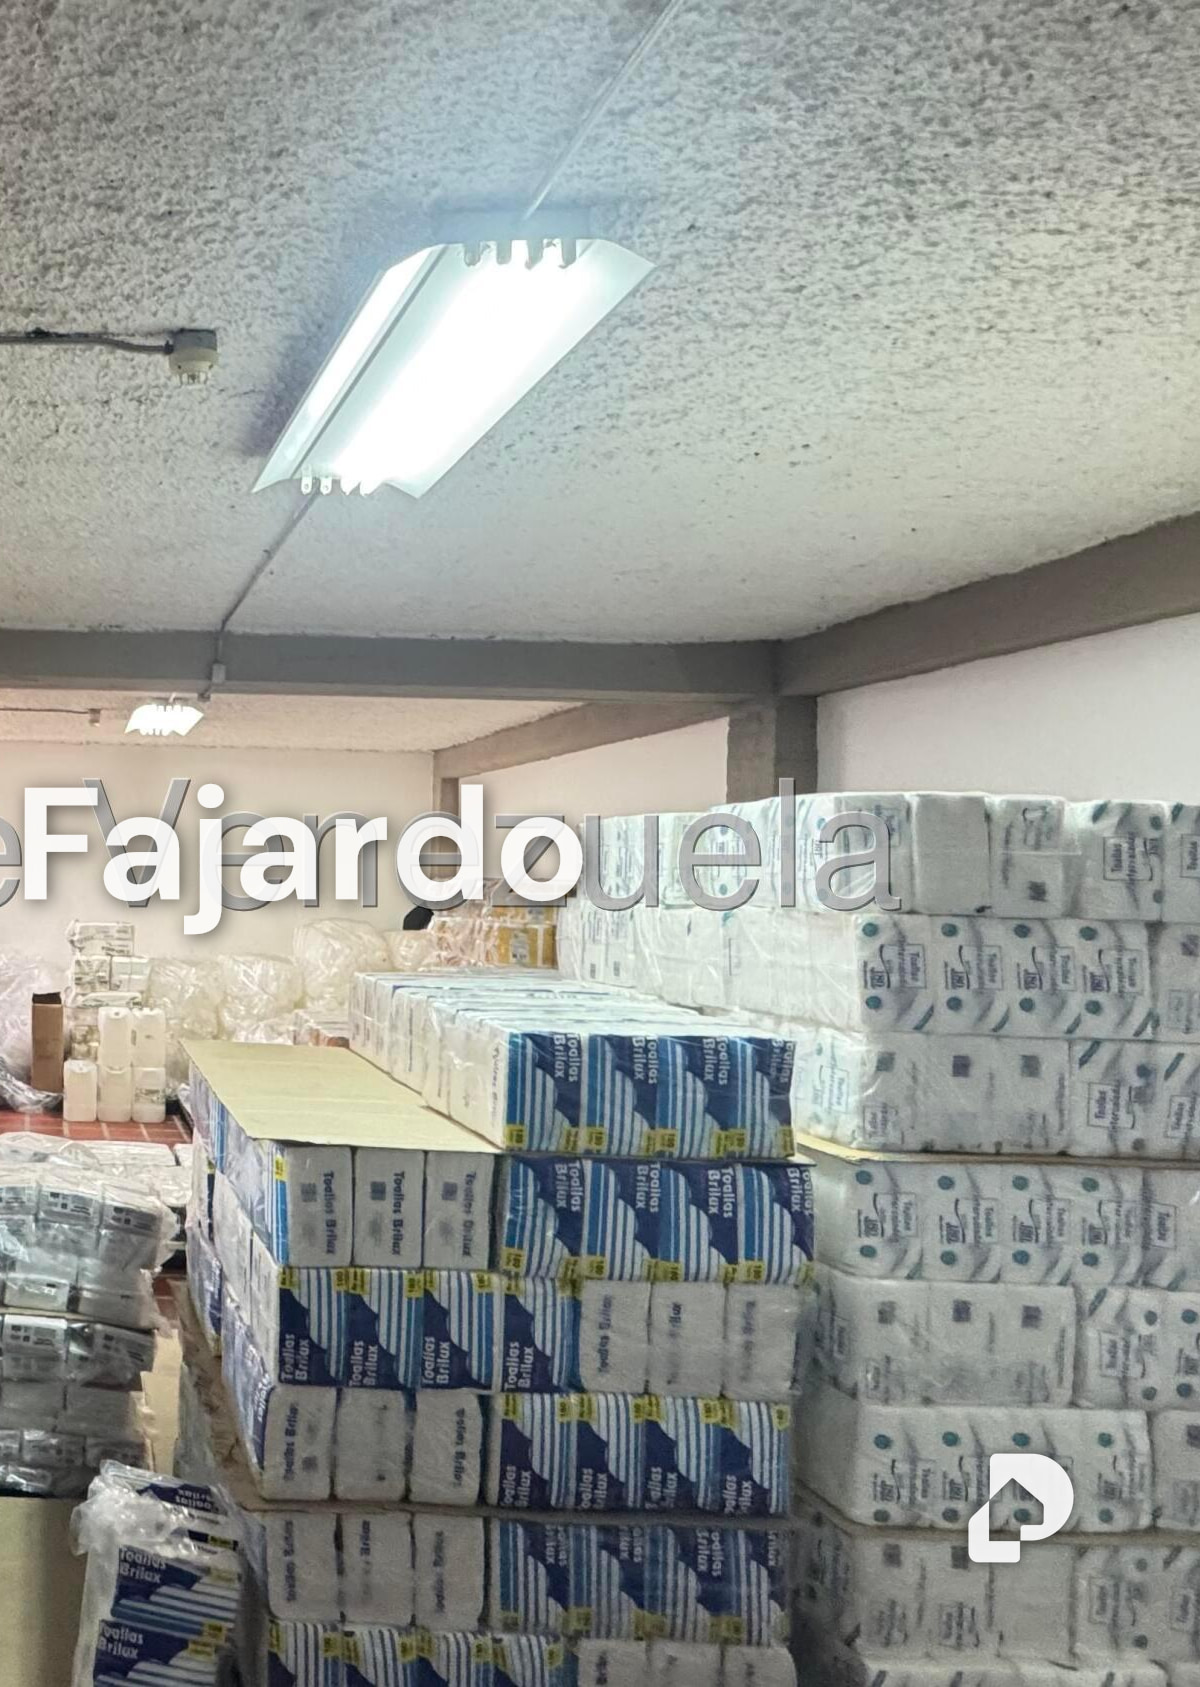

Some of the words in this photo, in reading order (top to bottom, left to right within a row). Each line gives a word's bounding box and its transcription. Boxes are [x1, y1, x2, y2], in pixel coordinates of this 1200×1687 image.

[553, 1035, 567, 1078] Brilux
[567, 1034, 580, 1082] Toallas
[632, 1037, 646, 1080] Brilux
[647, 1035, 658, 1084] Toallas
[703, 1039, 716, 1081] Brilux
[718, 1036, 731, 1086] Toallas
[780, 1041, 793, 1082] oallas
[393, 1171, 405, 1214] Toallas
[555, 1164, 567, 1208] Brilux
[569, 1160, 583, 1211] Toallas
[636, 1165, 649, 1209] Brilux
[650, 1163, 660, 1212] Toallas
[708, 1170, 721, 1214] Brilux
[722, 1168, 734, 1218] Toallas
[786, 1168, 803, 1212] Brilux
[326, 1219, 336, 1255] Brilux
[392, 1219, 403, 1256] Brilux
[281, 1334, 295, 1381] Toallas
[296, 1339, 308, 1380] Brilux
[350, 1340, 363, 1386] Toallas
[363, 1345, 378, 1385] Brilux
[421, 1336, 435, 1384] Toallas
[436, 1341, 450, 1384] Brilux
[504, 1341, 520, 1390] Toallas
[518, 1346, 534, 1388] Brilux
[174, 1495, 213, 1511] oallas
[502, 1465, 516, 1506] oallas
[579, 1468, 593, 1508] oallas
[723, 1475, 737, 1514] oallas
[737, 1481, 752, 1513] rilux
[120, 1548, 167, 1570] Toallas
[120, 1564, 162, 1584] Brilux
[711, 1531, 724, 1576] oallas
